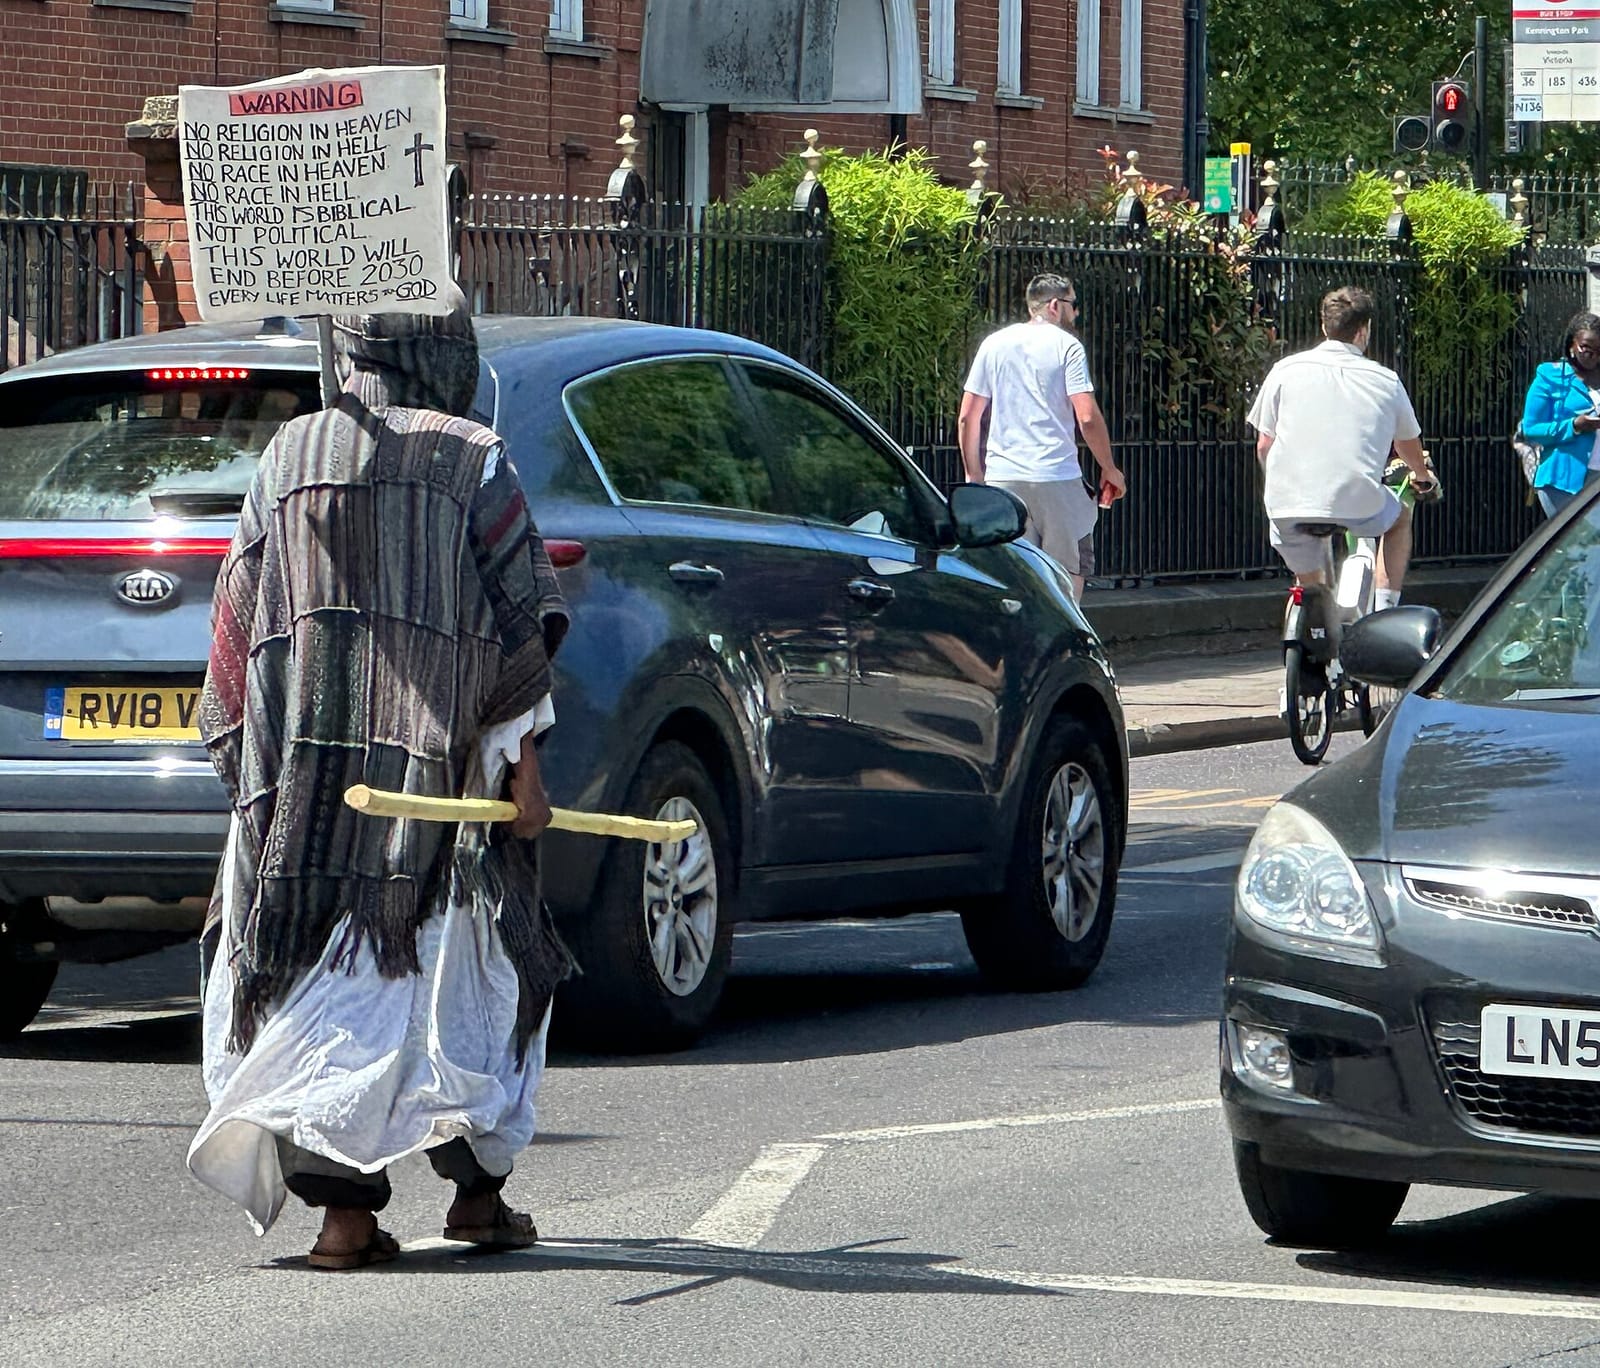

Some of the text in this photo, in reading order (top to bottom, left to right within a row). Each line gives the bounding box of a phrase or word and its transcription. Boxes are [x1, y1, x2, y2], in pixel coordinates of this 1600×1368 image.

[1525, 26, 1589, 36] Kennington Park
[1543, 56, 1573, 64] Victoria
[1521, 76, 1535, 87] 36
[1548, 76, 1566, 87] 185
[1578, 76, 1598, 87] 436
[238, 83, 357, 113] WARNING
[1515, 102, 1543, 112] N136
[183, 106, 412, 142] NO RELIGION IN HEAVEN
[185, 141, 214, 160] NO
[218, 143, 304, 161] RELIGION
[311, 143, 331, 160] IN
[188, 161, 215, 181] NO
[221, 163, 271, 183] RACE
[277, 163, 299, 182] IN
[190, 181, 219, 200] NO
[224, 185, 274, 205] RACE
[280, 184, 300, 203] IN
[190, 202, 227, 223] THIS
[231, 206, 284, 225] WORLD
[292, 205, 315, 223] IS
[195, 222, 243, 243] NOT
[199, 237, 420, 269] THIS WORLD WILL
[210, 254, 423, 289] END BEFORE 2030
[209, 288, 260, 307] EVERY
[266, 291, 300, 305] LIFE
[306, 289, 378, 306] MATTERS
[395, 278, 437, 301] GOD
[125, 579, 164, 598] KIA
[79, 693, 162, 729] RV18
[1506, 1015, 1600, 1068] LN5
